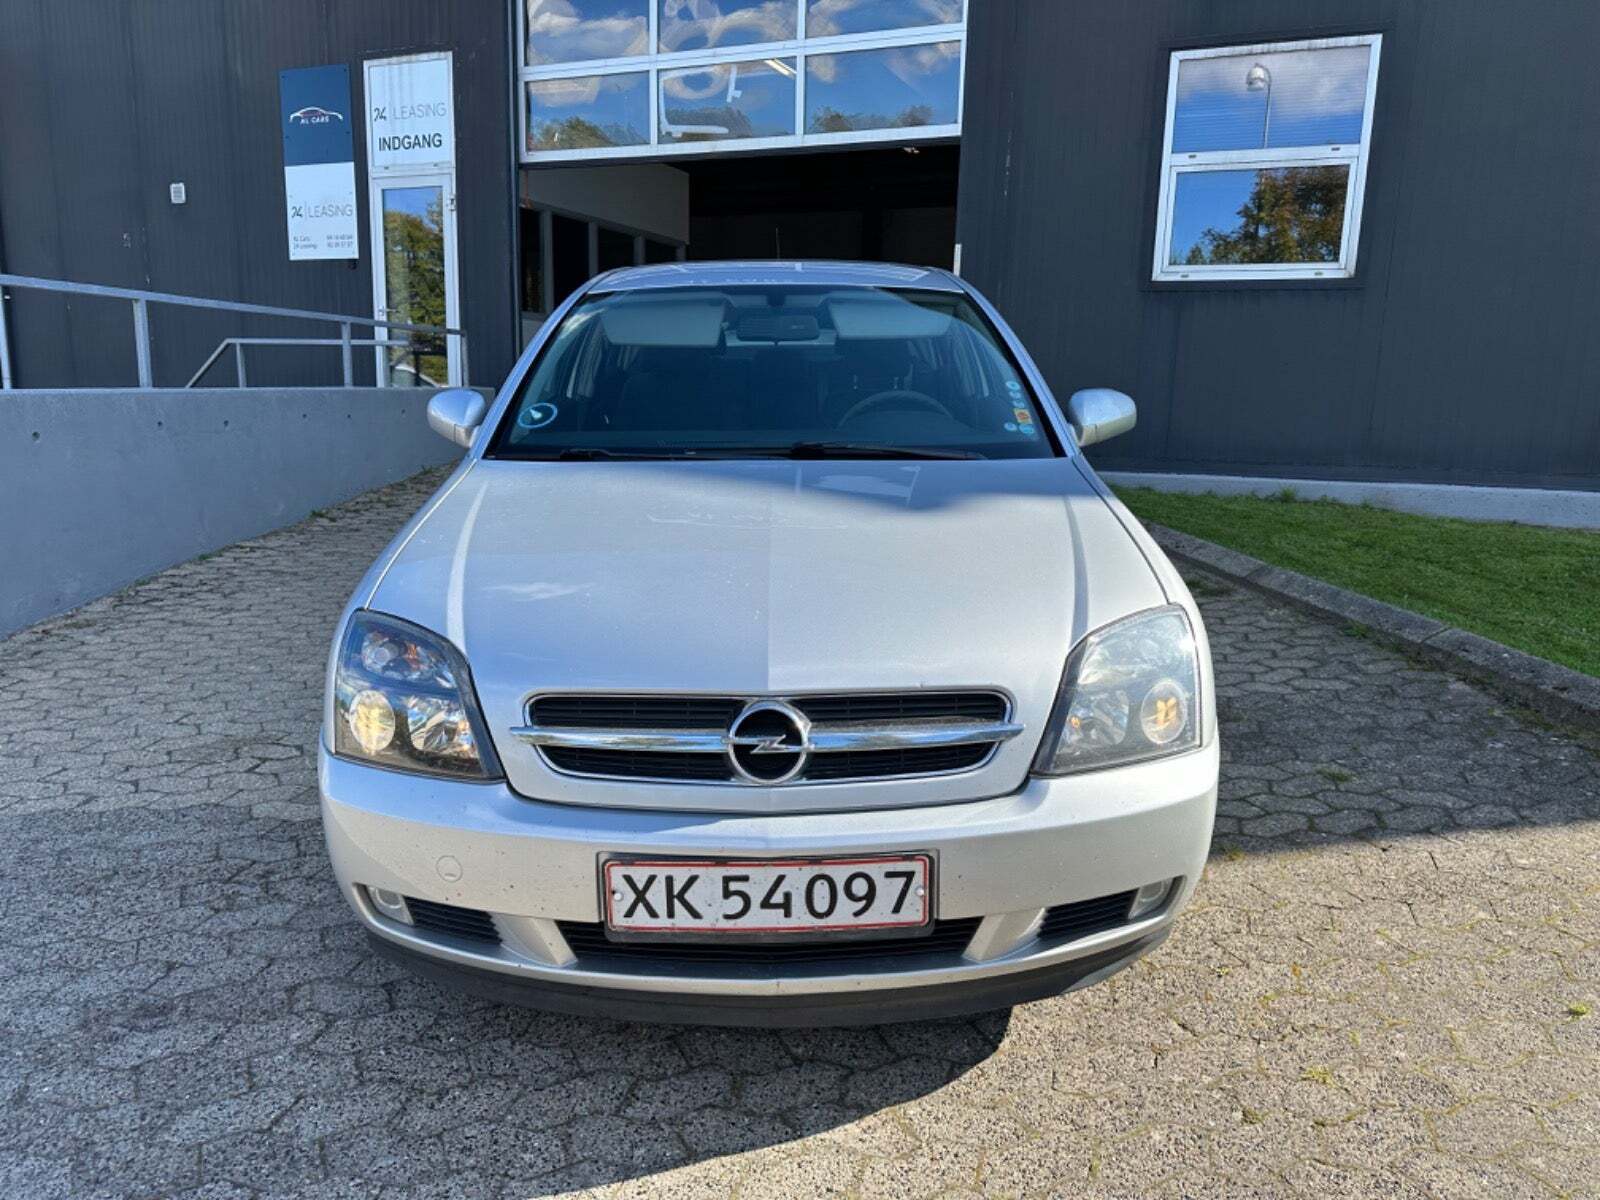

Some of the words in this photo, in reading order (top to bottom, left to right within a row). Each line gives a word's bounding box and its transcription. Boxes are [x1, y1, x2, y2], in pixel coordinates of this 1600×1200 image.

[392, 102, 447, 119] LEASING
[378, 132, 442, 151] INDGANG
[308, 203, 353, 218] LEASING
[622, 874, 703, 919] XK
[721, 871, 916, 920] 54097
